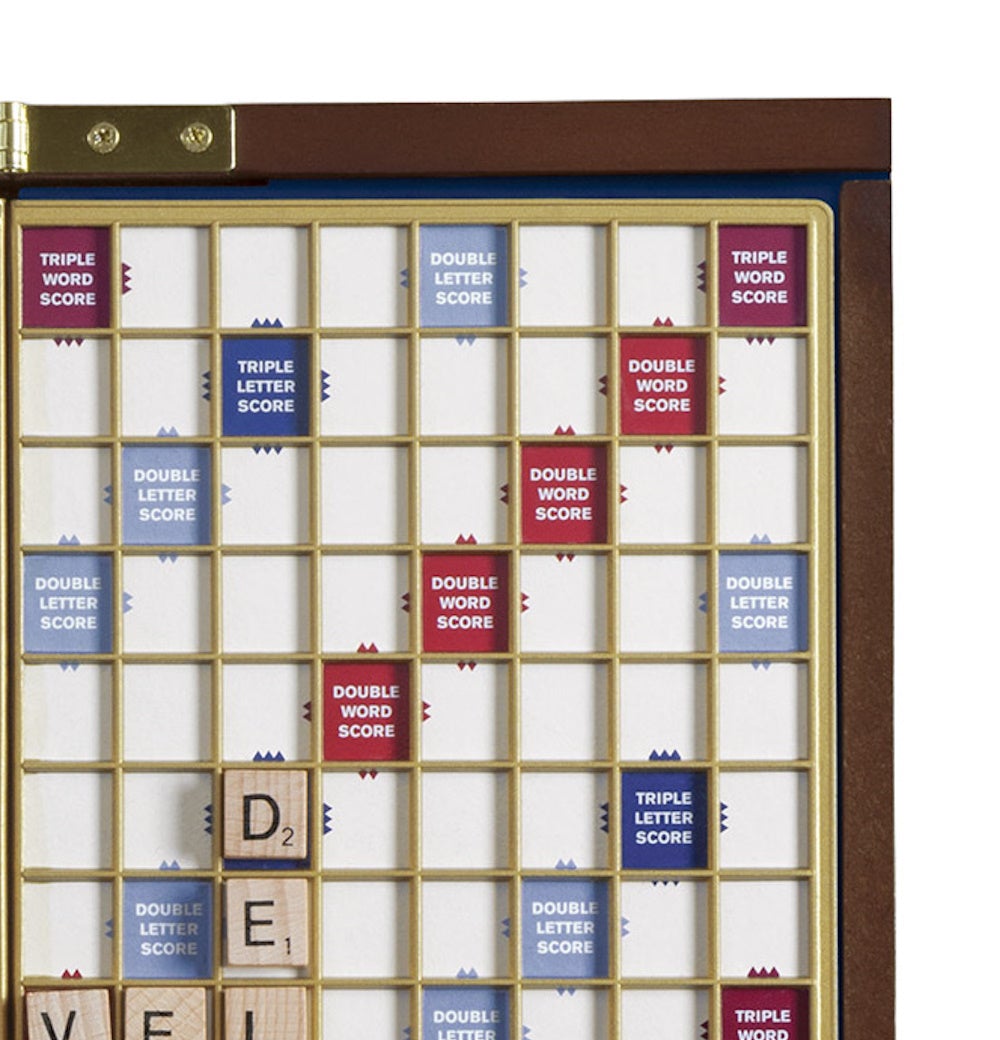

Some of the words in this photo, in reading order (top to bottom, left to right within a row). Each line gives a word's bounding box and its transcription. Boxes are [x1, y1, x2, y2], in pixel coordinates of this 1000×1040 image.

[38, 252, 96, 267] TRIPLE
[429, 251, 497, 266] DOUBLE
[730, 250, 788, 265] TRIPLE
[41, 271, 95, 287] WORD
[434, 271, 494, 286] LETTER
[733, 269, 786, 285] WORD
[39, 291, 97, 307] SCORE
[435, 290, 493, 306] SCORE
[730, 289, 789, 305] SCORE
[236, 359, 295, 375] TRIPLE
[628, 358, 696, 374] DOUBLE
[236, 379, 296, 394] LETTER
[635, 378, 689, 393] WORD
[237, 398, 296, 414] SCORE
[633, 397, 692, 413] SCORE
[133, 468, 201, 483] DOUBLE
[137, 488, 197, 503] LETTER
[138, 507, 197, 522] SCORE
[34, 576, 101, 591] DOUBLE
[431, 575, 499, 591] DOUBLE
[39, 595, 99, 611] LETTER
[438, 595, 492, 611] WORD
[39, 615, 97, 631] SCORE
[436, 614, 494, 630] SCORE
[634, 790, 693, 806] TRIPLE
[634, 810, 694, 826] LETTER
[635, 829, 693, 845] SCORE
[134, 902, 202, 917] DOUBLE
[139, 922, 199, 937] LETTER
[140, 941, 198, 957] SCORE
[733, 1008, 792, 1024] TRIPLE
